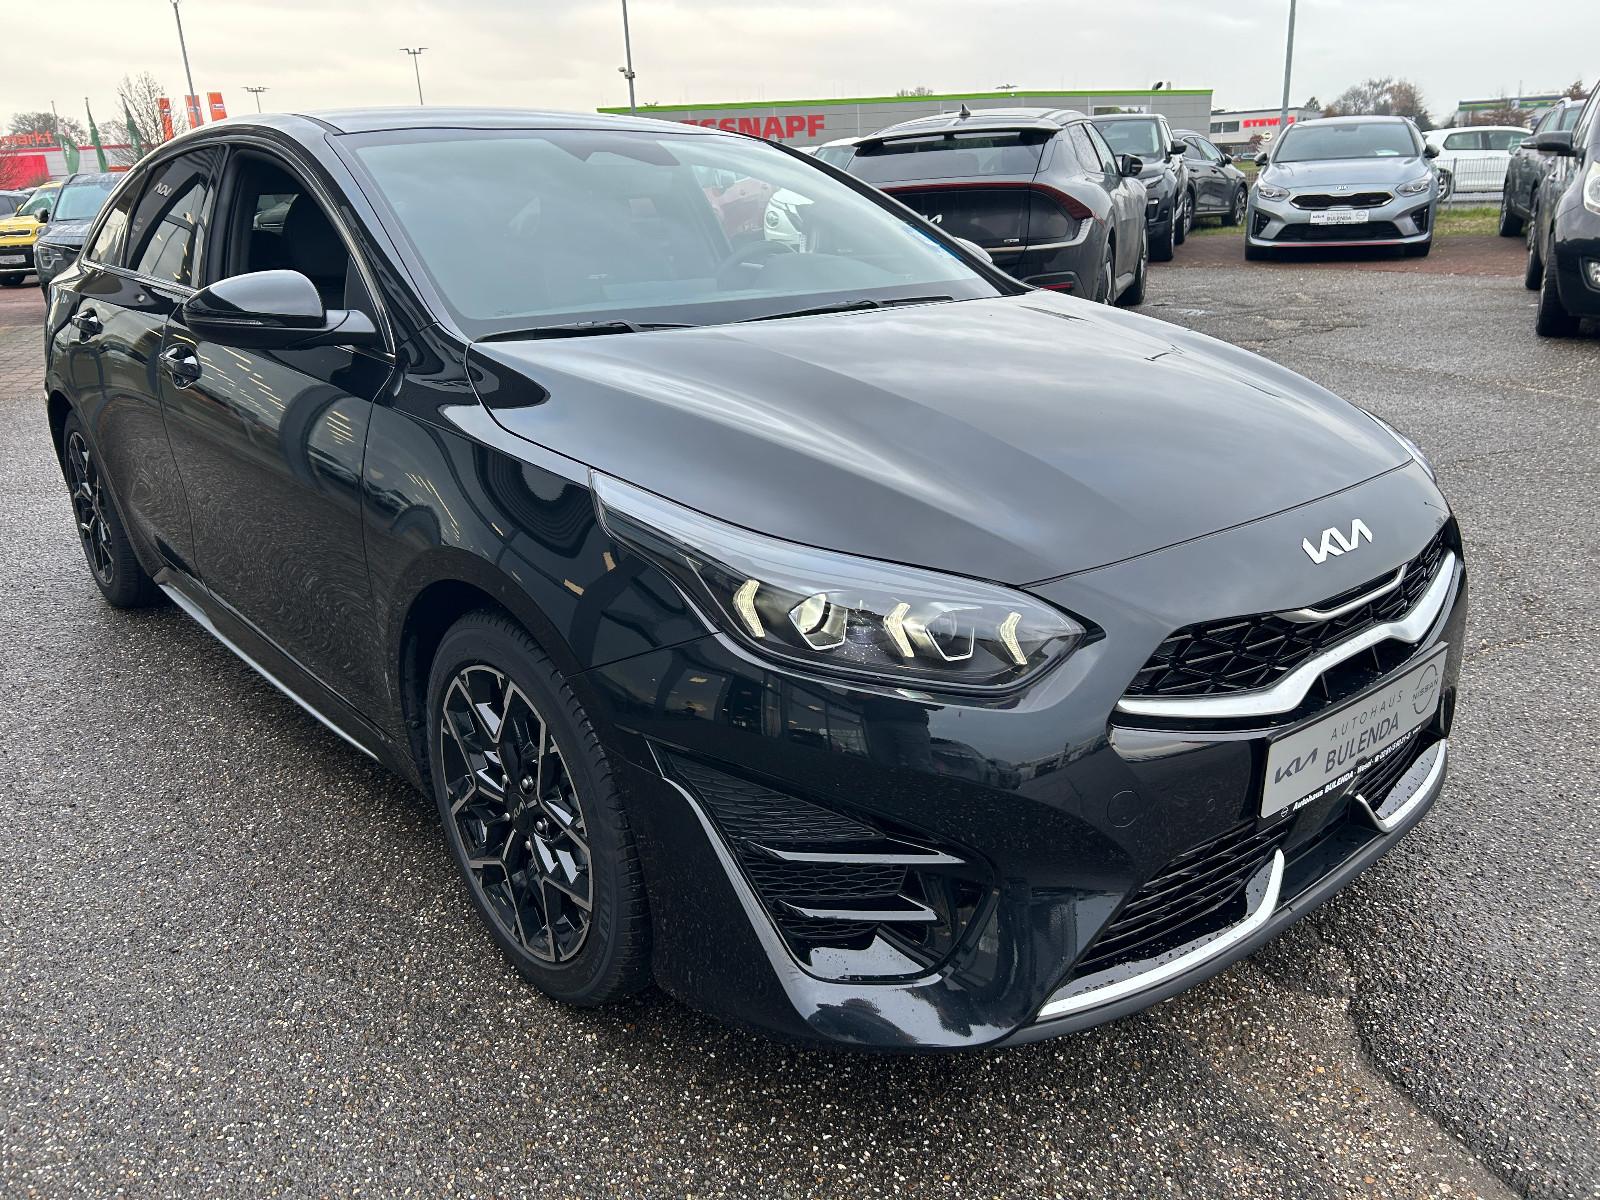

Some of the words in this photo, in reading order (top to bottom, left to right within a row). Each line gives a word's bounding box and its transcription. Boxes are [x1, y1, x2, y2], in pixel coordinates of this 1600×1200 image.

[679, 114, 824, 139] SNAPF
[1302, 518, 1373, 565] KIA
[1412, 677, 1439, 700] NISSAN
[1331, 690, 1403, 741] AUTOHAUS
[1325, 712, 1399, 774] BULENDA
[1275, 747, 1318, 785] KIA
[1292, 789, 1324, 812] Autohaus
[1324, 770, 1354, 794] BULENDA
